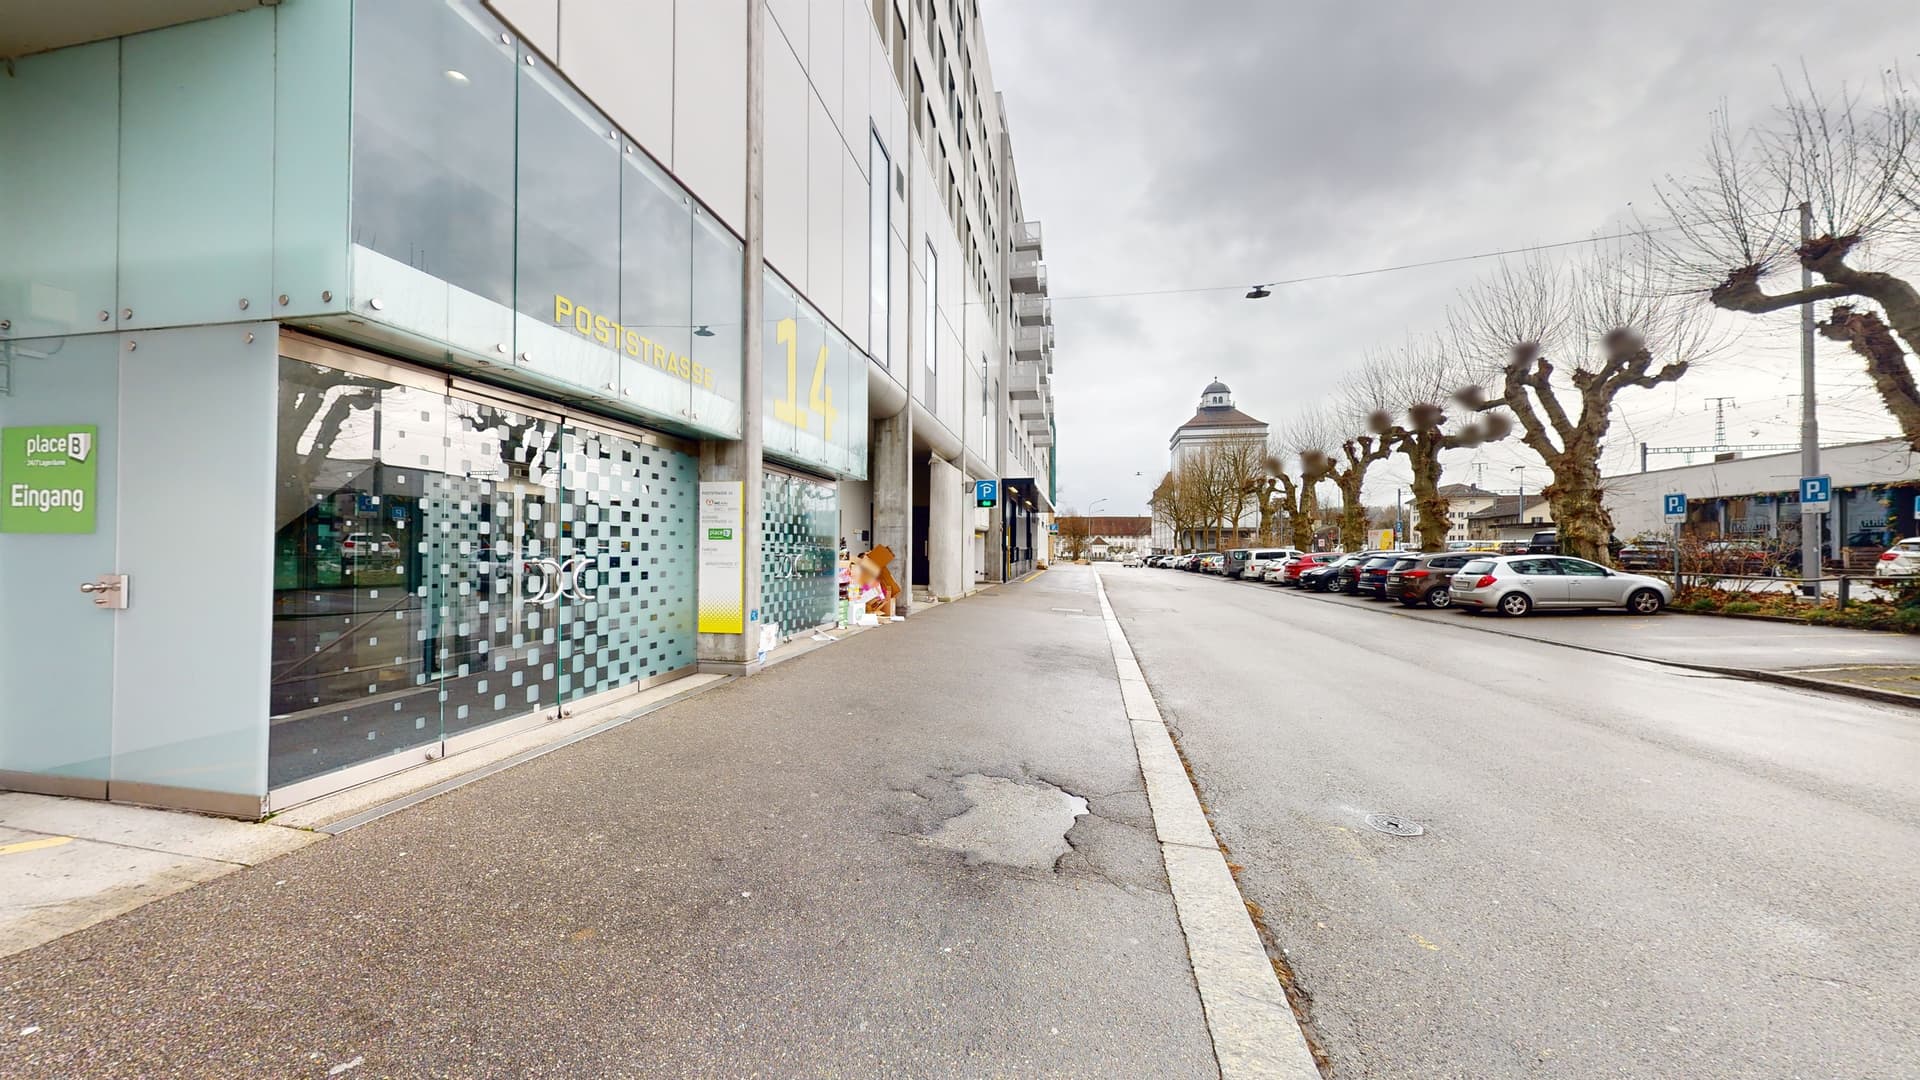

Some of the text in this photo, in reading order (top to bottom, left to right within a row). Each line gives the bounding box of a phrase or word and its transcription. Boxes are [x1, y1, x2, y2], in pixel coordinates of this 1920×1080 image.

[555, 294, 714, 388] POSTSTRASSE
[773, 318, 838, 441] 14
[11, 484, 84, 512] Eingang
[983, 486, 992, 498] P
[1806, 481, 1820, 499] P
[1669, 497, 1679, 512] P
